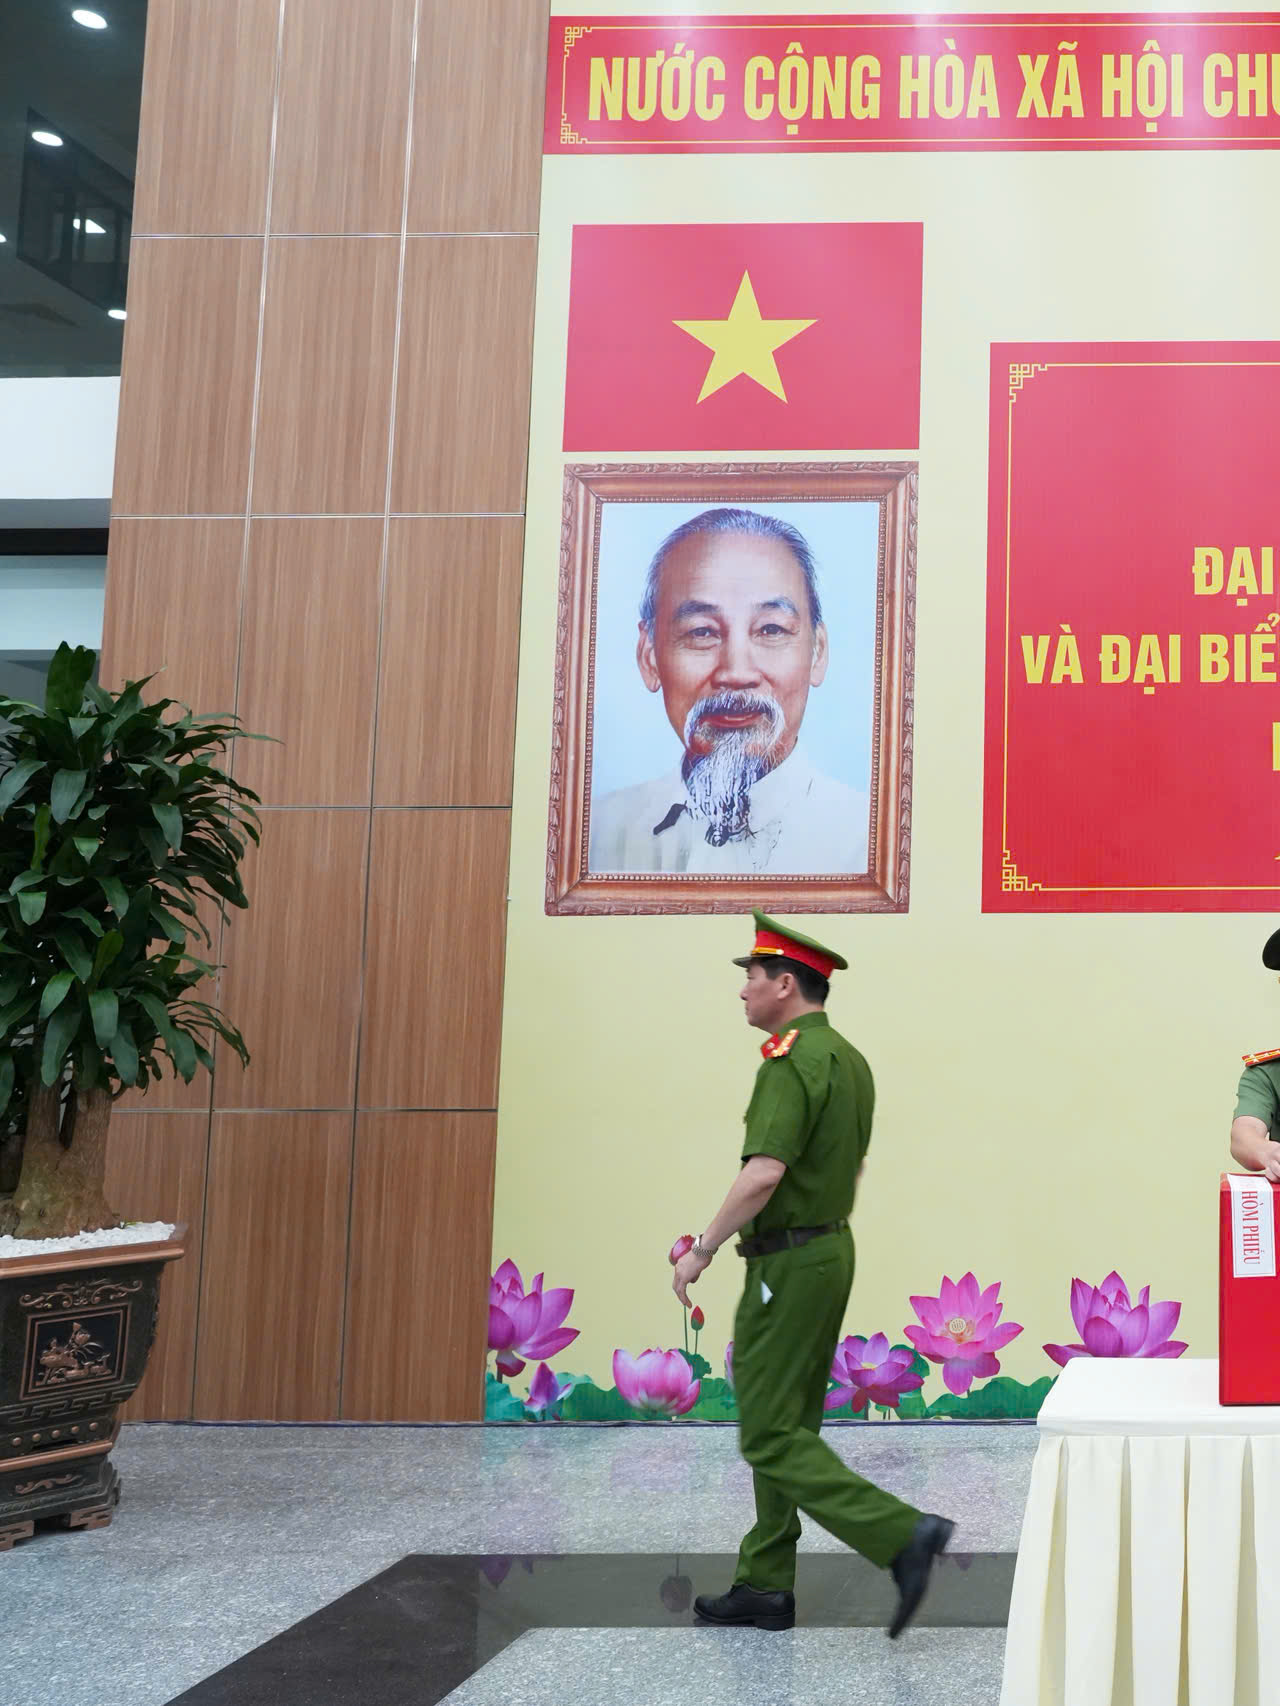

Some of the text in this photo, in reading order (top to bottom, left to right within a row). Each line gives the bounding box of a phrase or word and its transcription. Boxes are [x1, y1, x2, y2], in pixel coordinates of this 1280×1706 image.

[589, 44, 725, 120] NƯỚC
[744, 42, 880, 134] CỘNG
[900, 39, 1000, 118] HÒA
[1018, 41, 1084, 118] XÃ
[1102, 40, 1184, 132] HỘI
[1192, 547, 1274, 606] ĐẠI
[1021, 623, 1084, 684] VÀ
[1099, 635, 1181, 695] ĐẠI
[1241, 1190, 1264, 1222] HÒM
